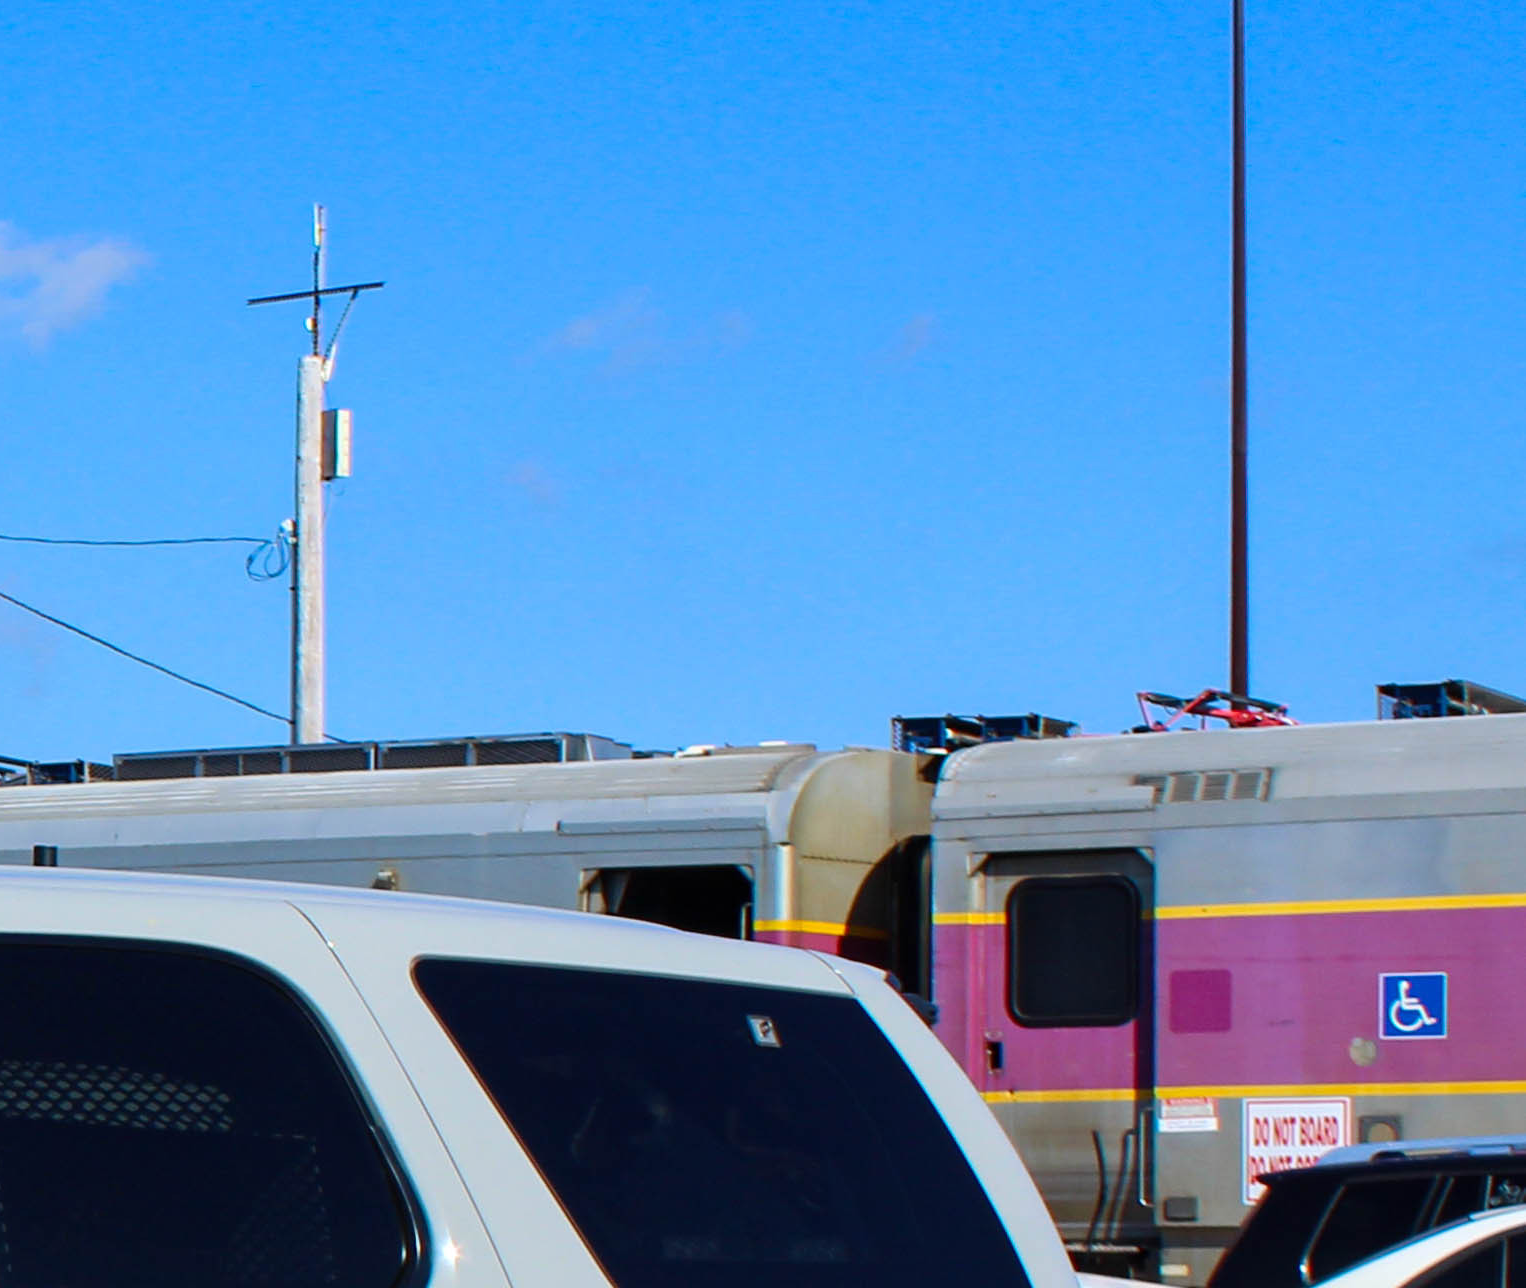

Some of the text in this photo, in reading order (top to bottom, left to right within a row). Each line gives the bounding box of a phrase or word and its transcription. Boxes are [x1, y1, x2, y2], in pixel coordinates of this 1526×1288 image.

[1253, 1116, 1339, 1146] DO NOT BOARD
